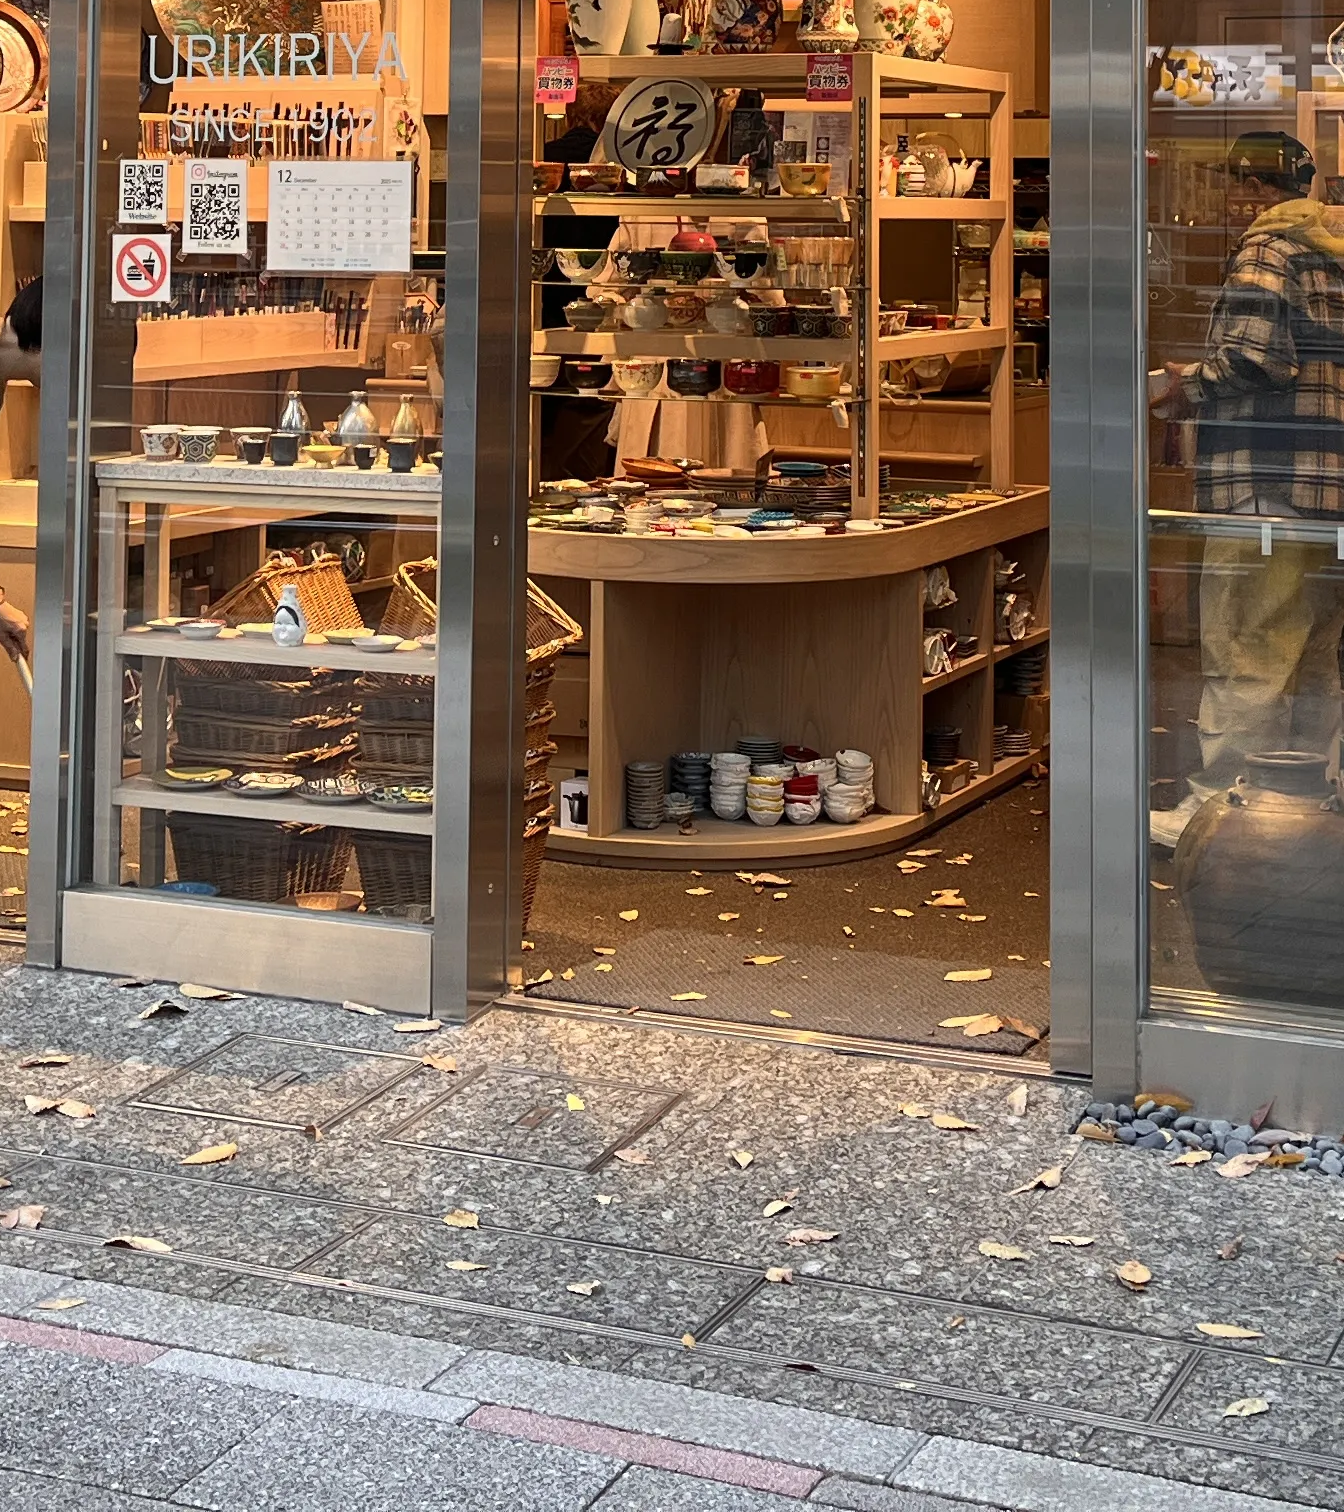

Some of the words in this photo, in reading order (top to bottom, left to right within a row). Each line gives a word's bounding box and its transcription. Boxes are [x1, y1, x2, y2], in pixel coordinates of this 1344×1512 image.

[148, 32, 408, 84] URIKIRIYA
[171, 109, 274, 142] SINCE
[291, 108, 378, 142] 1902
[277, 169, 292, 183] 12
